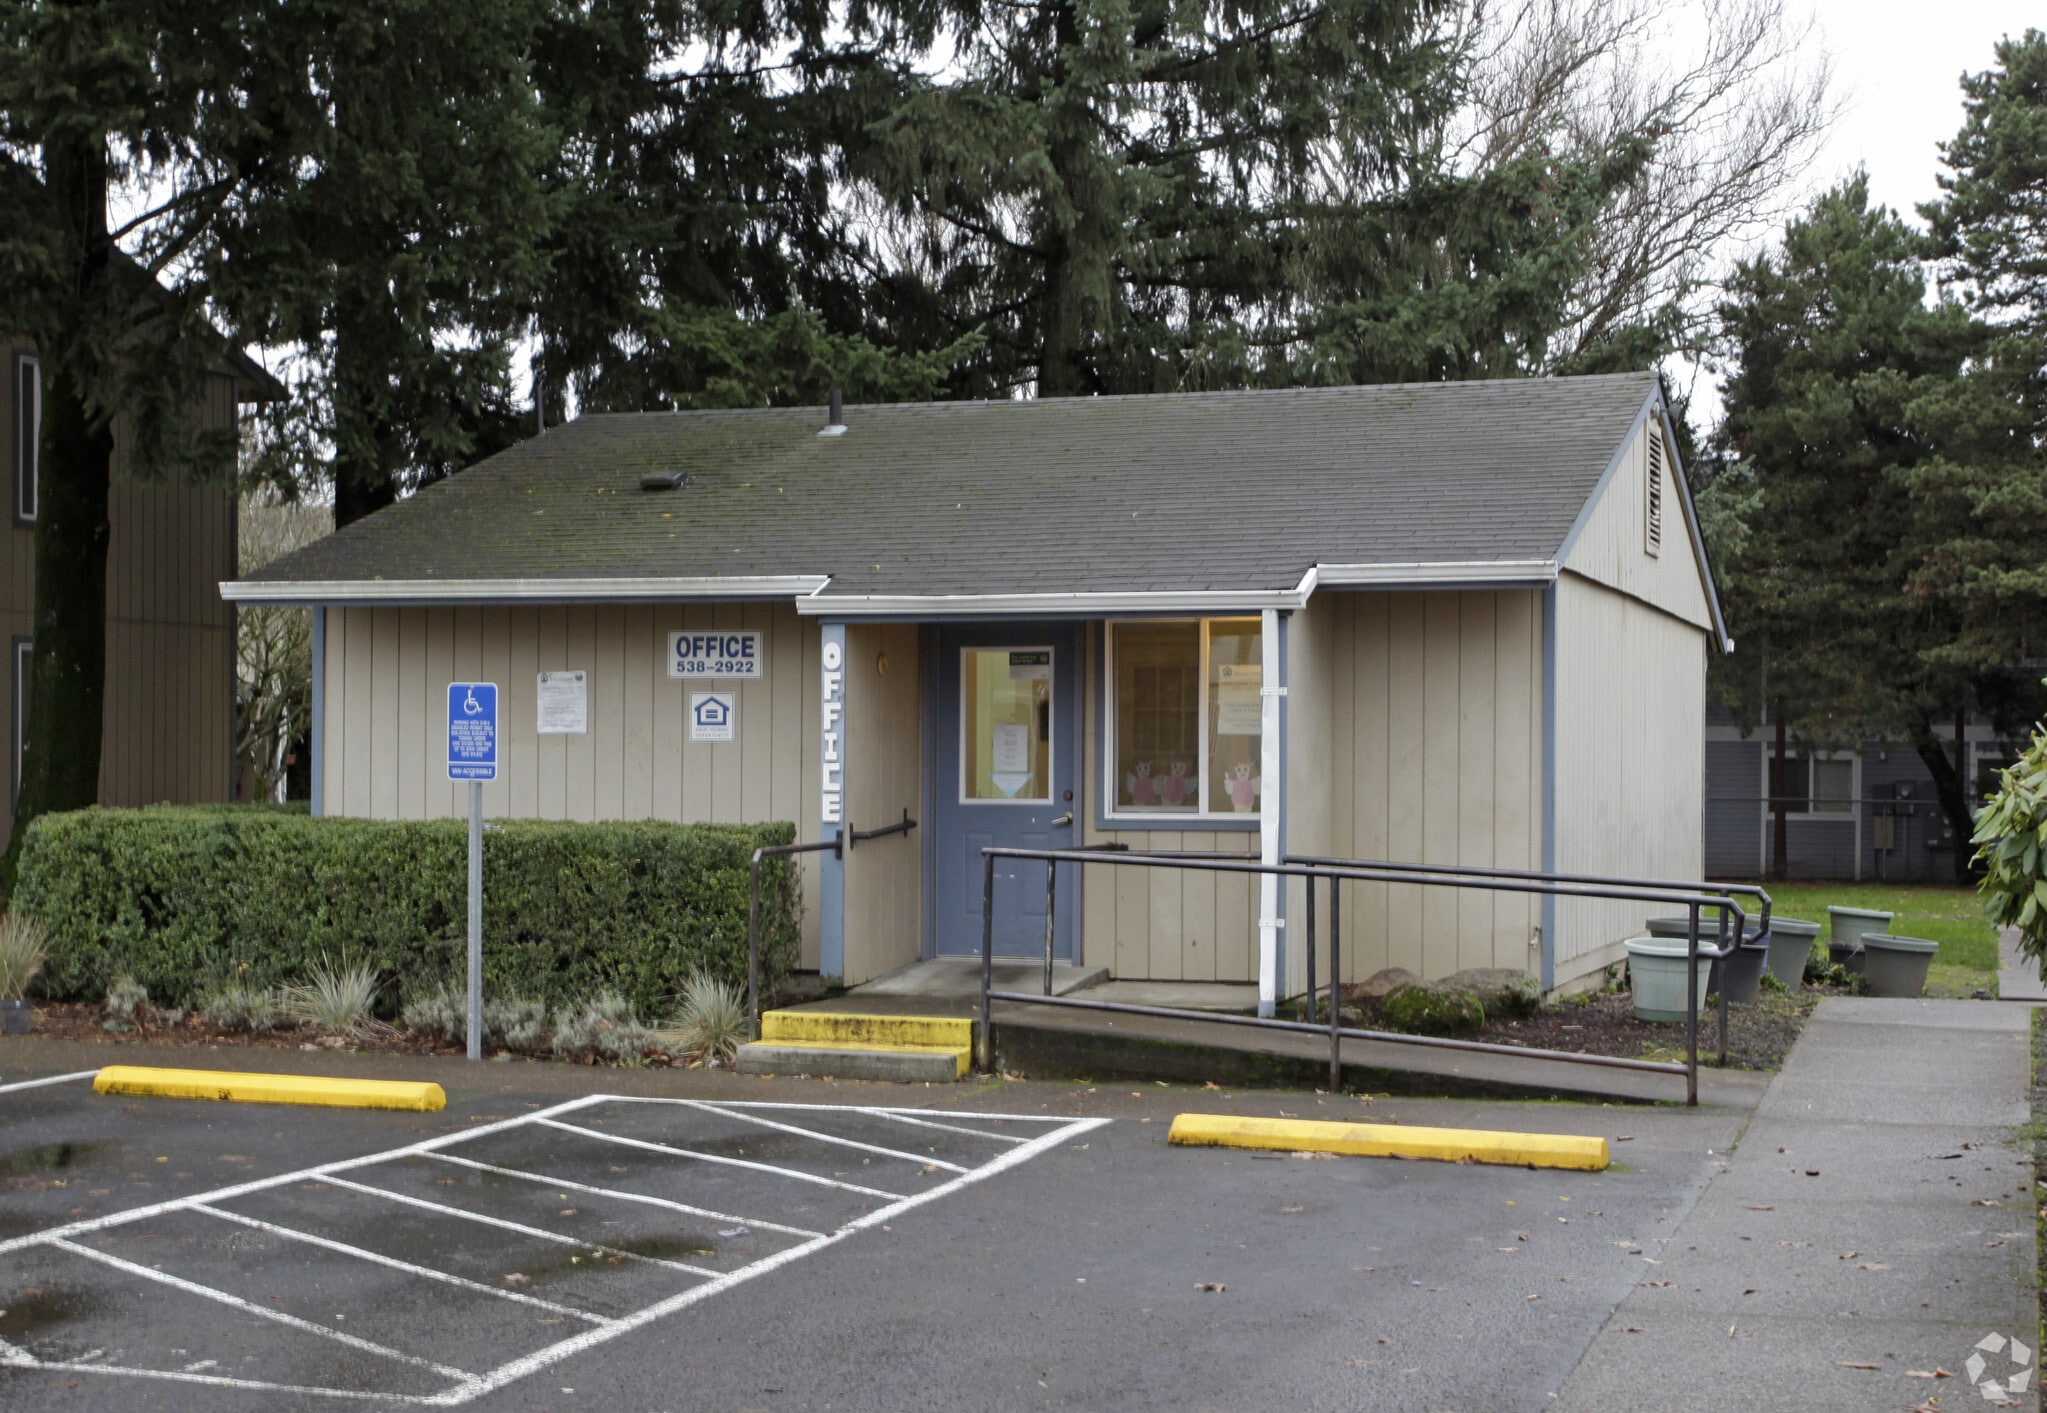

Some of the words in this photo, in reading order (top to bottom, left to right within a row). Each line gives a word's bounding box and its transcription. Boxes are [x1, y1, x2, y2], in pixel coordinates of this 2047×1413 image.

[676, 635, 755, 658] OFFICE
[676, 660, 754, 673] 538-2922
[822, 641, 842, 822] OFFICE
